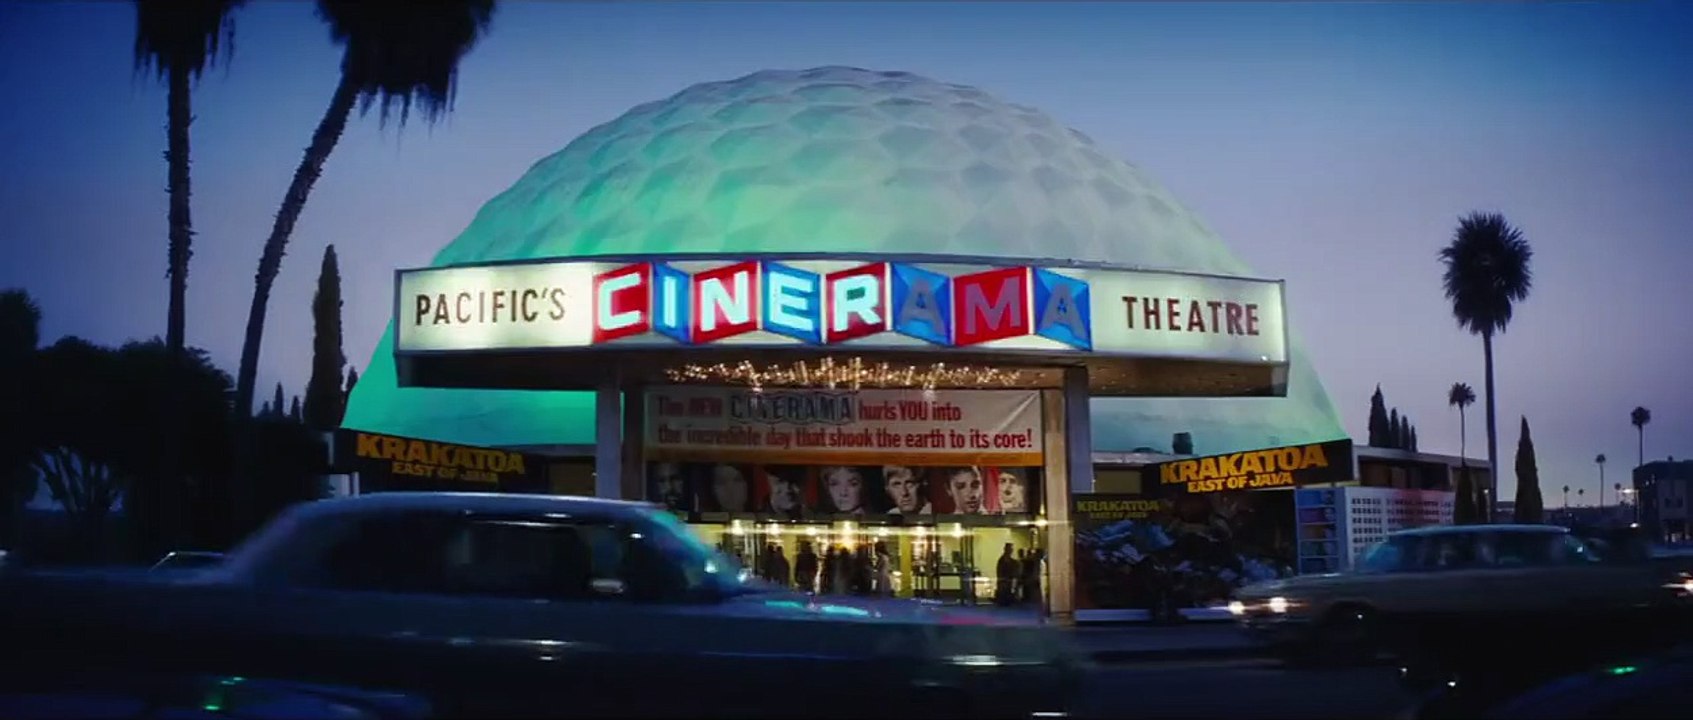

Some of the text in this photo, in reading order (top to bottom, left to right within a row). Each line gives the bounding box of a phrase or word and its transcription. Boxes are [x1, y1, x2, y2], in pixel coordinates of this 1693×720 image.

[415, 270, 1260, 348] PACIFIC'S CINERAMA THEATRE
[730, 394, 852, 420] CINERAMA
[859, 400, 896, 421] hurls
[900, 401, 928, 421] YOU
[932, 401, 962, 421] into
[658, 424, 1033, 449] the incredible day that shook the earth to its core!
[356, 432, 526, 475] KRAKATOA
[1160, 444, 1329, 484] KRAKATOA
[391, 461, 435, 477] EAST
[437, 467, 458, 480] OF
[1187, 472, 1294, 493] EAST OF JAVA
[1076, 500, 1160, 512] KRAKATOA
